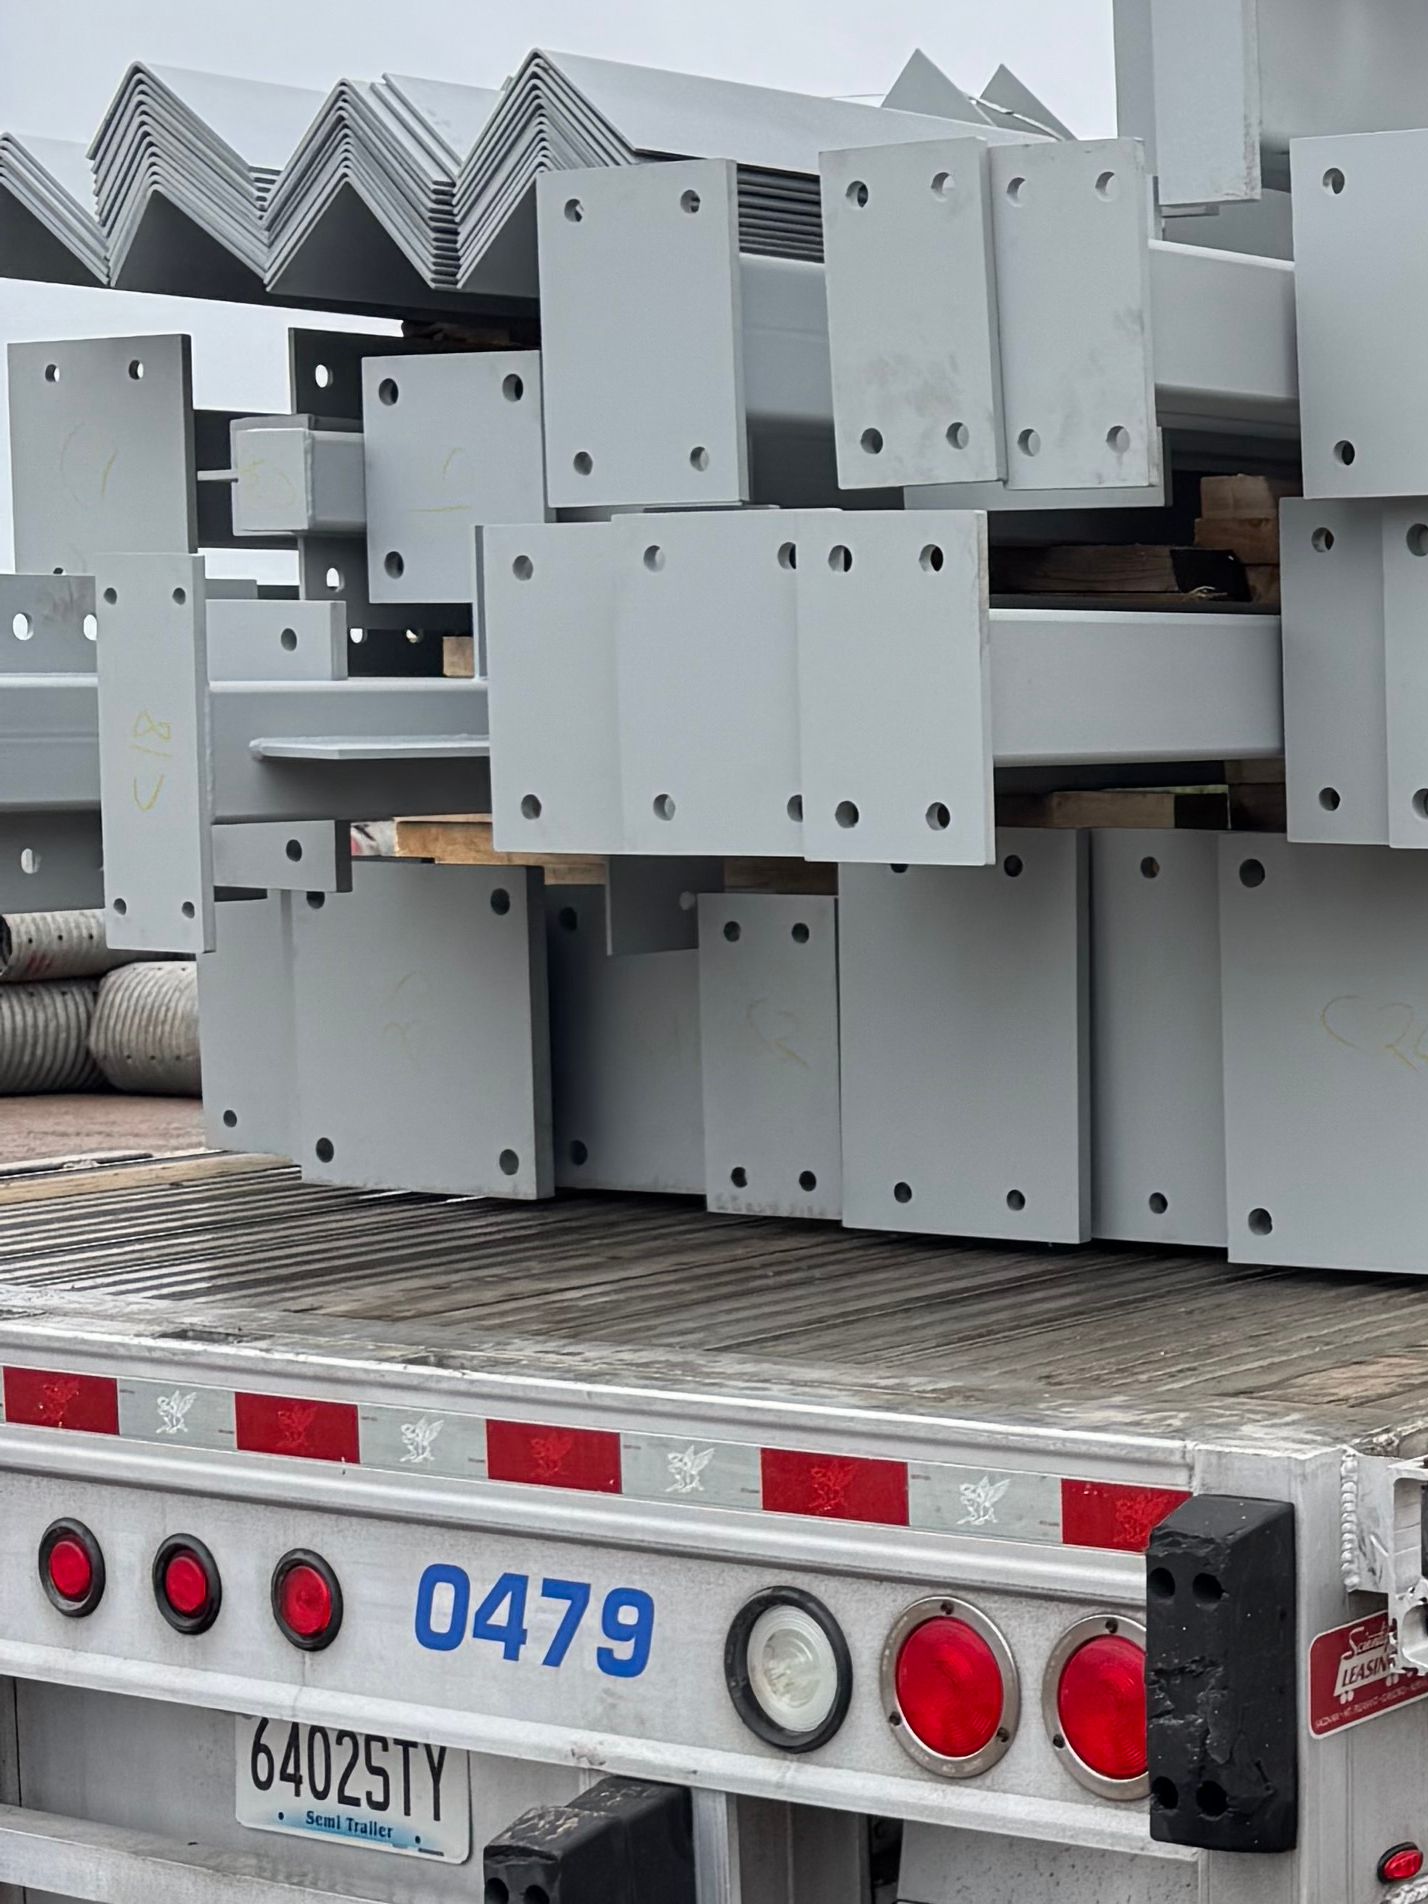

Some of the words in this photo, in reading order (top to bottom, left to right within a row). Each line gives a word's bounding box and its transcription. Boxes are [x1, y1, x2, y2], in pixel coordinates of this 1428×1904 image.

[414, 1562, 656, 1679] 0479
[1341, 1652, 1397, 1688] LEASIN
[251, 1716, 448, 1822] 6402STY
[305, 1809, 341, 1829] Semi
[345, 1816, 394, 1839] Trailer
